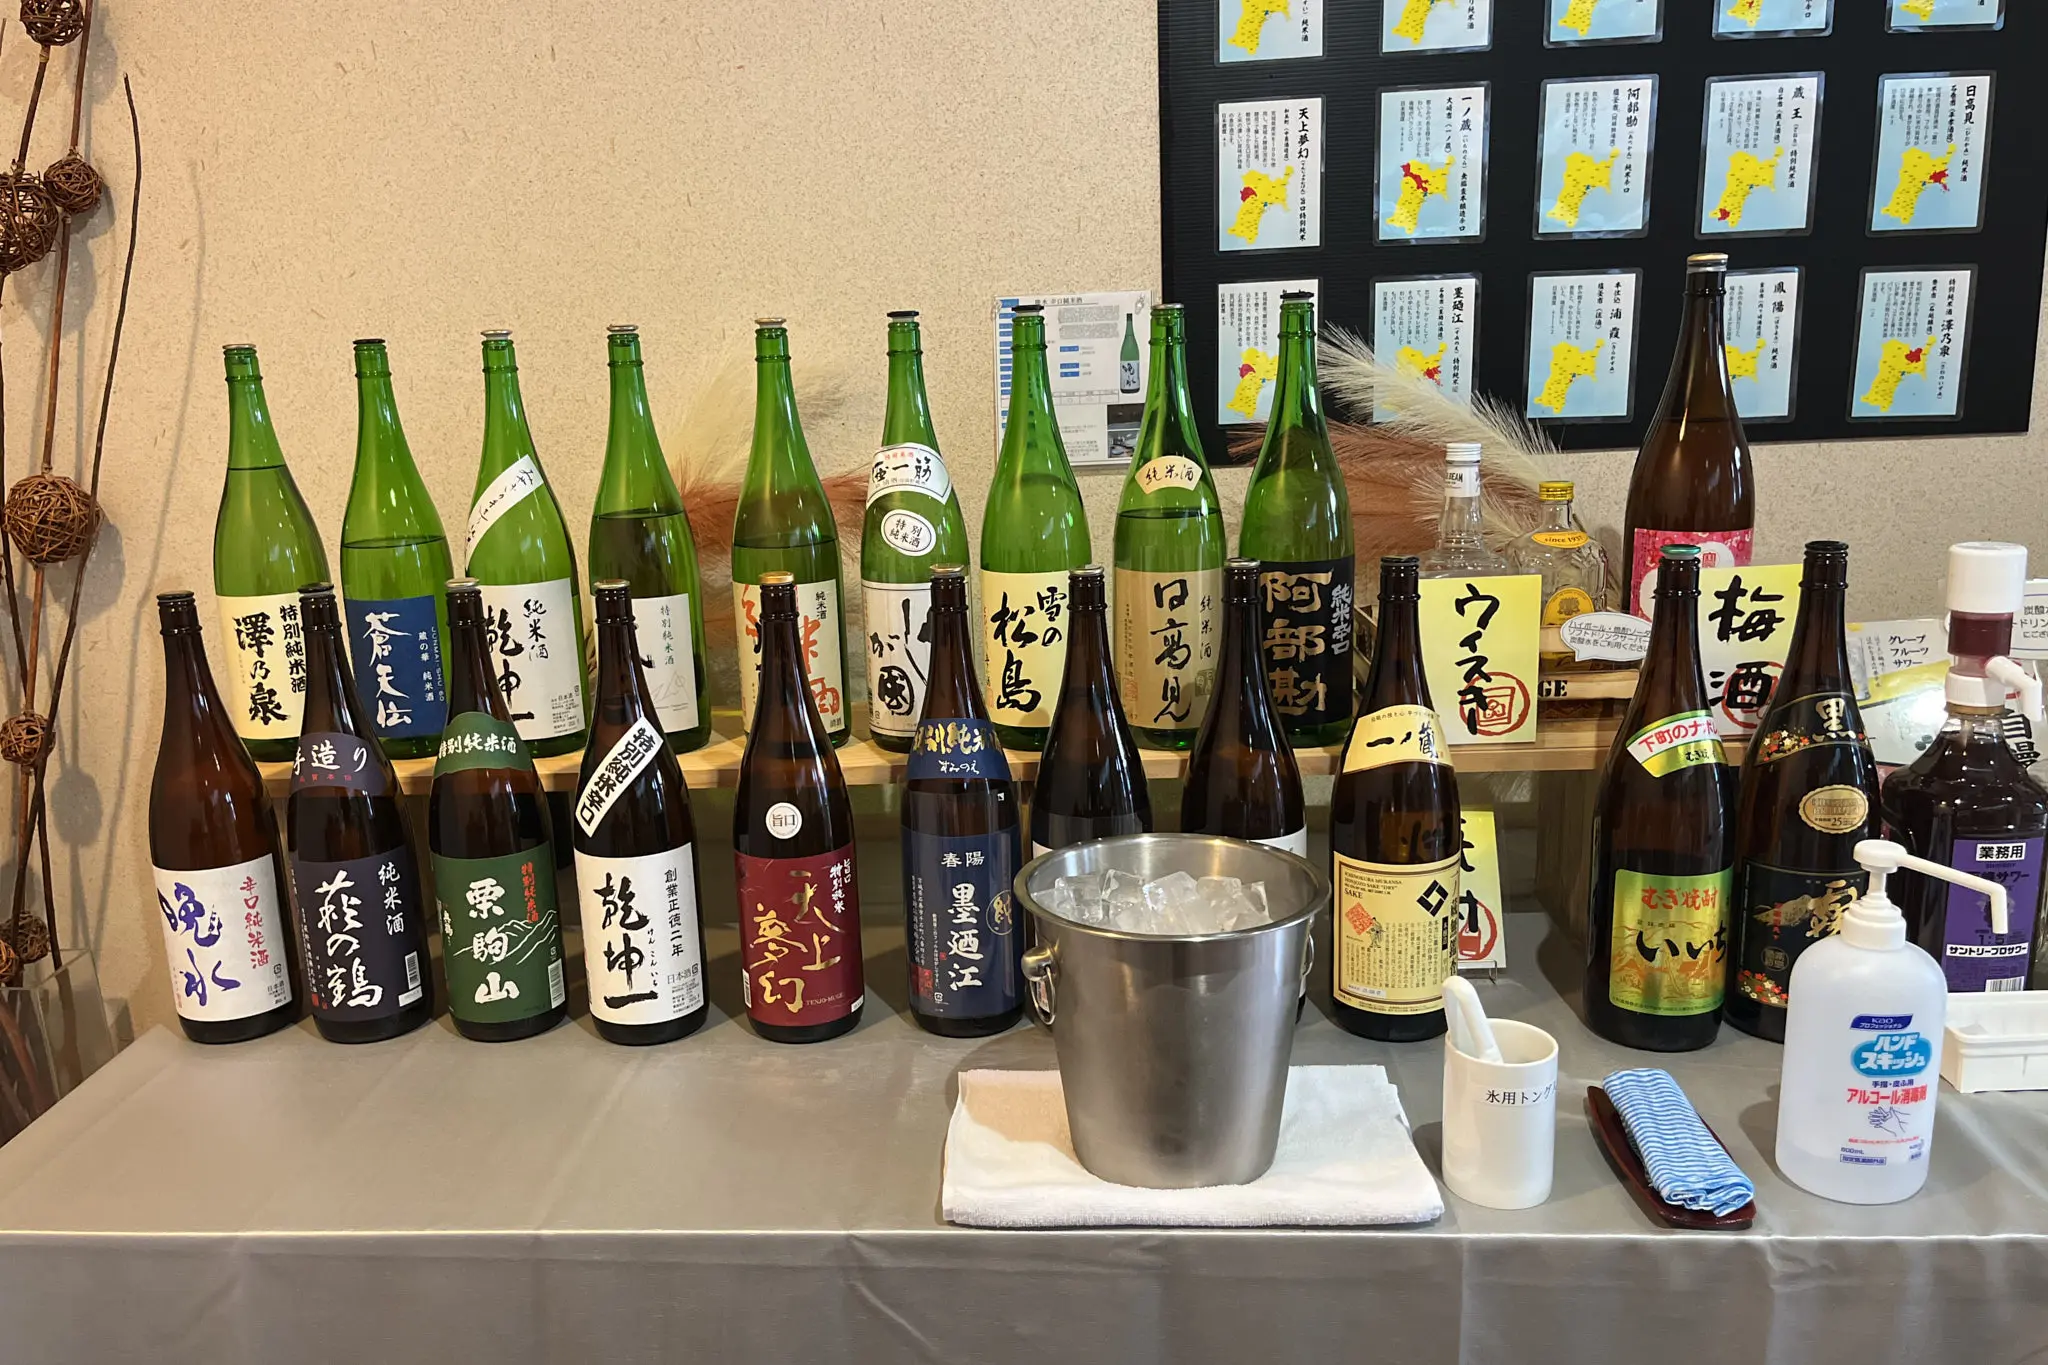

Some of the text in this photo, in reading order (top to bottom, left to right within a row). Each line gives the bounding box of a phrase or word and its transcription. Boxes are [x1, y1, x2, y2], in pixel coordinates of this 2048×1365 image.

[1459, 96, 1472, 132] 一ノ蔵
[1626, 87, 1641, 128] 阿部勘
[1963, 85, 1977, 125] 日高見
[1298, 107, 1309, 159] 天上夢幻
[1787, 149, 1798, 188] 特別純米酒
[1960, 159, 1969, 182] 純米酒
[1772, 280, 1787, 313] 鳳陽
[1770, 347, 1779, 369] 純米酒
[1938, 318, 1954, 358] 澤乃泉
[1144, 463, 1194, 486] 純米酒
[815, 591, 827, 620] 純米酒
[1330, 584, 1353, 655] 純米辛口
[523, 598, 549, 663] 純米酒
[660, 605, 675, 666] 特別純米酒
[1200, 595, 1214, 660] 純米酒
[1260, 567, 1334, 718] 阿部勘
[1709, 574, 1785, 710] 梅酒
[1888, 634, 1926, 645] グレープ
[232, 611, 291, 725] 澤乃泉
[279, 604, 306, 694] 特別純米酒
[990, 592, 1041, 712] 松島
[1150, 578, 1192, 723] 日高見
[1890, 647, 1929, 656] フルーツ
[1893, 659, 1923, 668] サワー
[363, 611, 412, 728] 蒼天伝
[422, 671, 435, 702] 純米酒
[1366, 721, 1439, 759] 一ノ蔵
[1812, 697, 1857, 743] 黒
[438, 731, 517, 760] 特別純米酒
[579, 726, 656, 826] 特別純米辛口
[771, 813, 796, 827] 旨口
[1831, 817, 1842, 826] 25
[941, 851, 985, 868] 春陽
[1978, 845, 2024, 860] 業務用
[378, 862, 404, 937] 純米酒
[520, 861, 540, 924] 特別純米酒
[829, 863, 846, 914] 特別純米
[1344, 888, 1363, 899] SAKE
[1641, 886, 1719, 911] むぎ焼酎
[239, 876, 269, 970] 辛口純米酒
[664, 867, 684, 958] 創業正徳二年
[315, 869, 383, 1009] 萩の鶴
[465, 876, 520, 1004] 栗駒山
[593, 872, 658, 1010] 乾坤一
[945, 882, 984, 992] 墨廼江
[1949, 945, 2027, 956] サントリープロサワー
[667, 968, 691, 985] 日本酒
[806, 992, 846, 1006] TENJO-MUGE
[1860, 1051, 1926, 1071] スキッシュ
[1874, 1034, 1919, 1051] ハンド
[1847, 1084, 1928, 1105] アルコール消毒剤
